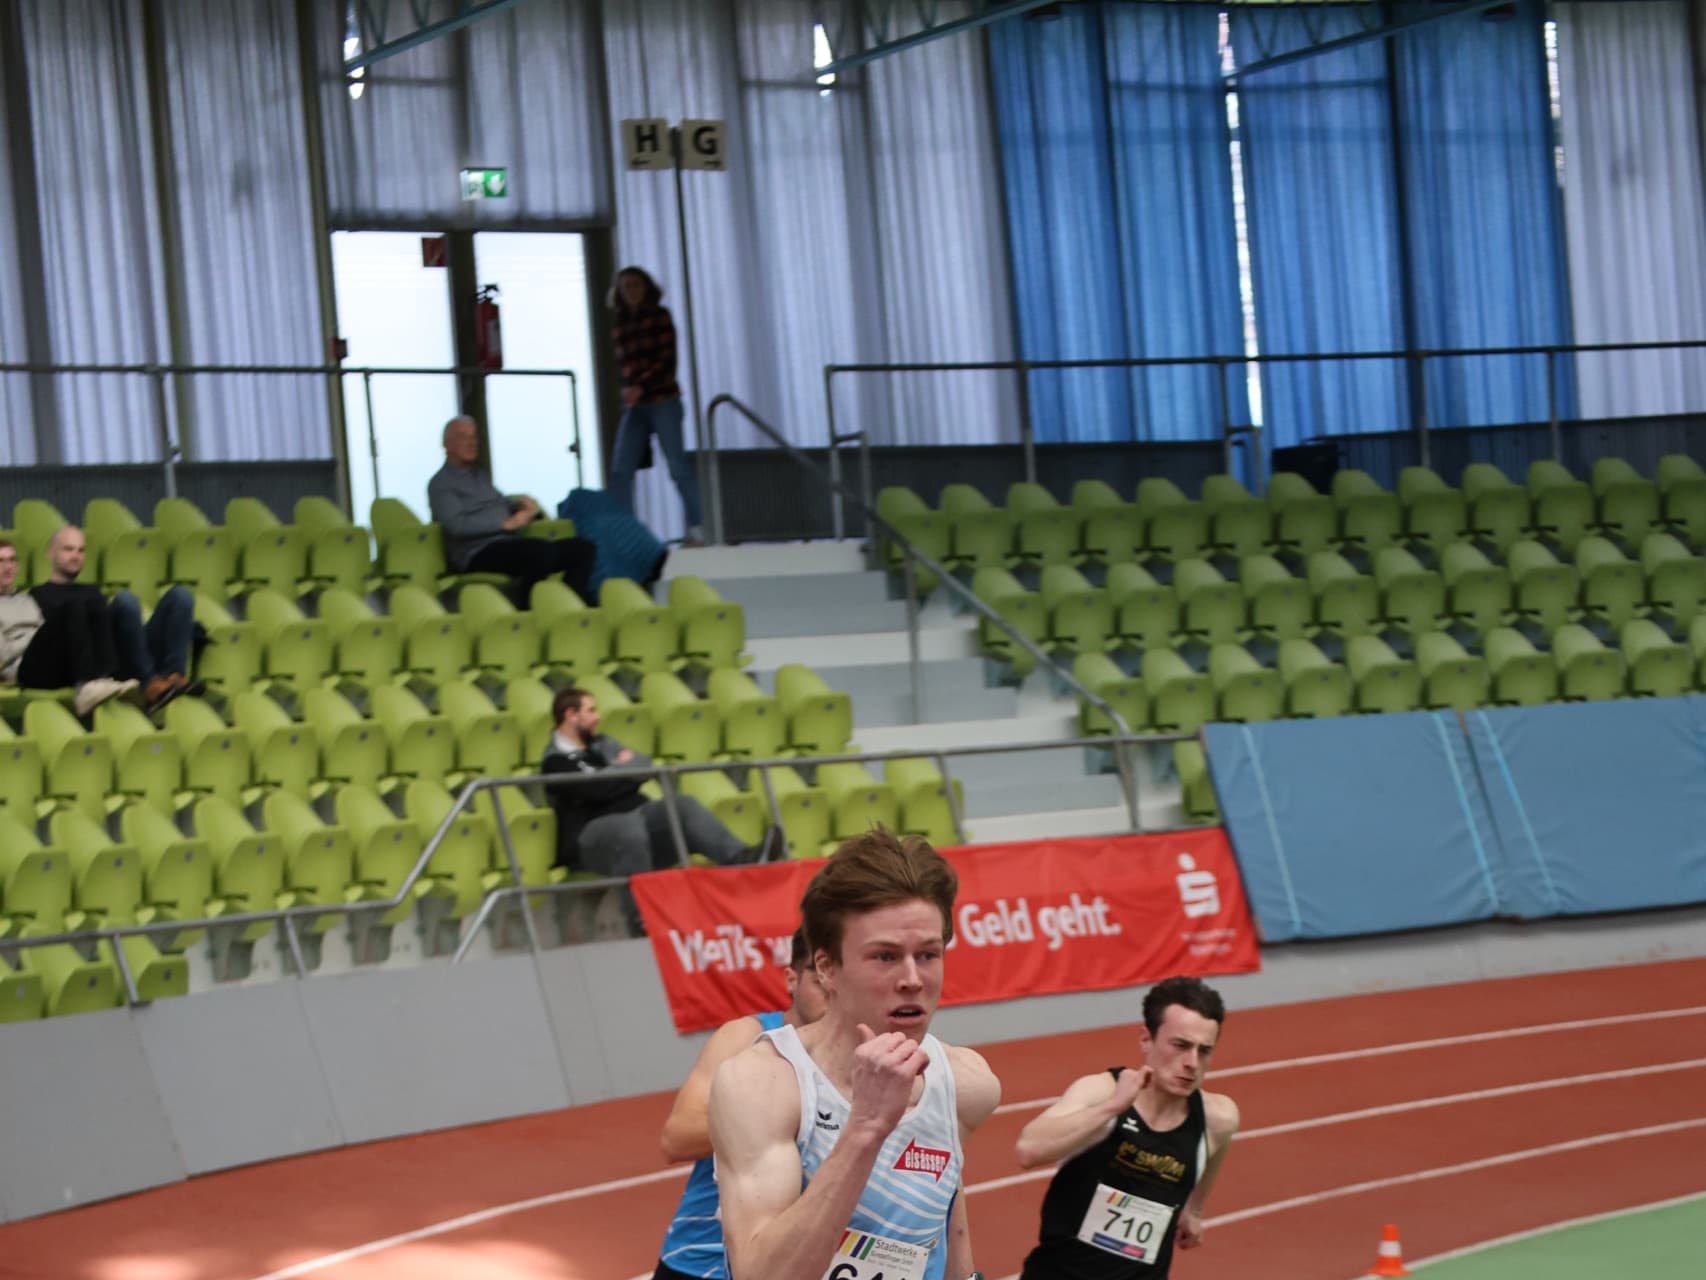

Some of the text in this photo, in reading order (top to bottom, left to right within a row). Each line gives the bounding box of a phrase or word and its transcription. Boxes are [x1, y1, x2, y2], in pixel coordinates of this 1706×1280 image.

[634, 124, 660, 153] H
[693, 125, 718, 155] G
[959, 897, 1034, 948] Geld
[1038, 893, 1122, 950] geht.
[905, 1148, 946, 1173] elsässer
[1103, 1208, 1154, 1243] 710
[874, 1238, 918, 1258] Stadtwerke
